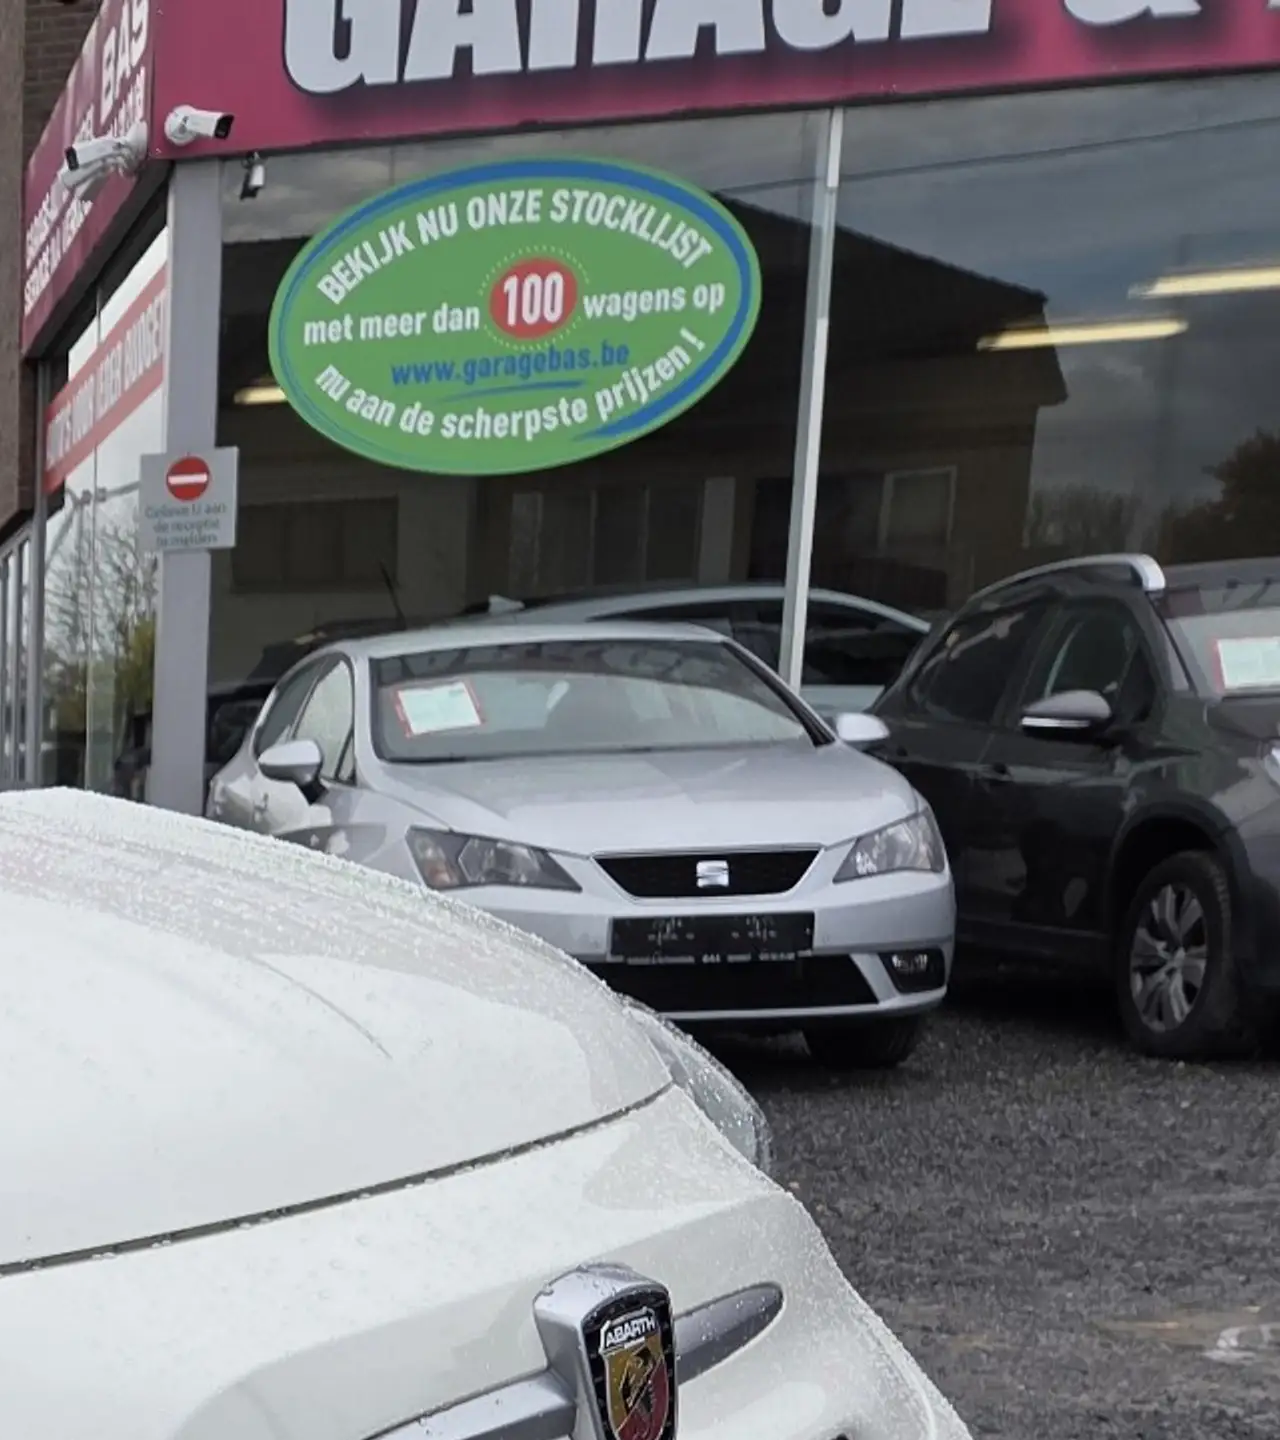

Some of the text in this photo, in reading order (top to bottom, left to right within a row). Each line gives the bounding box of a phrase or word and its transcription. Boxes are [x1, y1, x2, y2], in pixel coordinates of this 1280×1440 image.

[285, 0, 991, 94] GAAG
[316, 188, 713, 305] BEKIJK NU ONZE STOCKLIJST
[303, 271, 726, 346] met meer dan 100 wagens op
[314, 326, 707, 442] nu aan de scherpste prijzen !
[391, 339, 630, 386] www.garagebas.be
[606, 1314, 656, 1348] ABARTH
